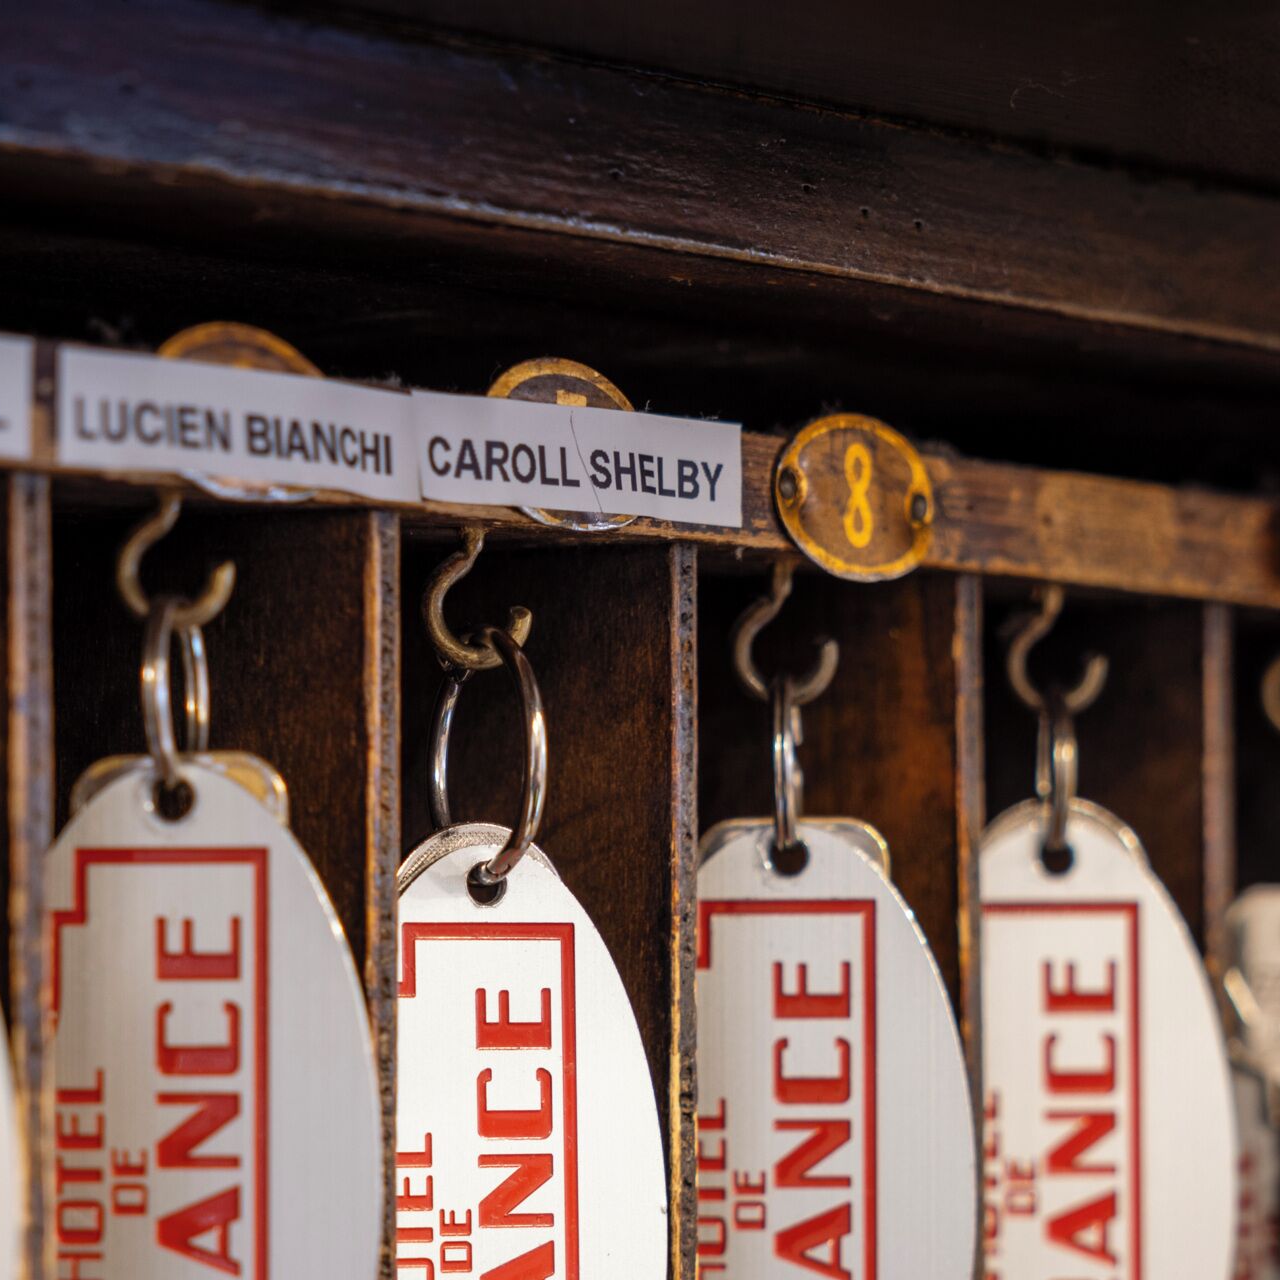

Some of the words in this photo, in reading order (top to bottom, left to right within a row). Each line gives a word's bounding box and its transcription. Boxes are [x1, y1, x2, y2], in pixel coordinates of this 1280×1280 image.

[73, 395, 231, 454] LUCIEN
[246, 413, 394, 476] BIANCHI
[427, 436, 581, 489] CAROLL
[589, 449, 724, 502] SHELBY
[843, 441, 873, 549] 8
[111, 1148, 148, 1216] DE
[733, 1170, 767, 1232] DE
[439, 1208, 472, 1273] DE
